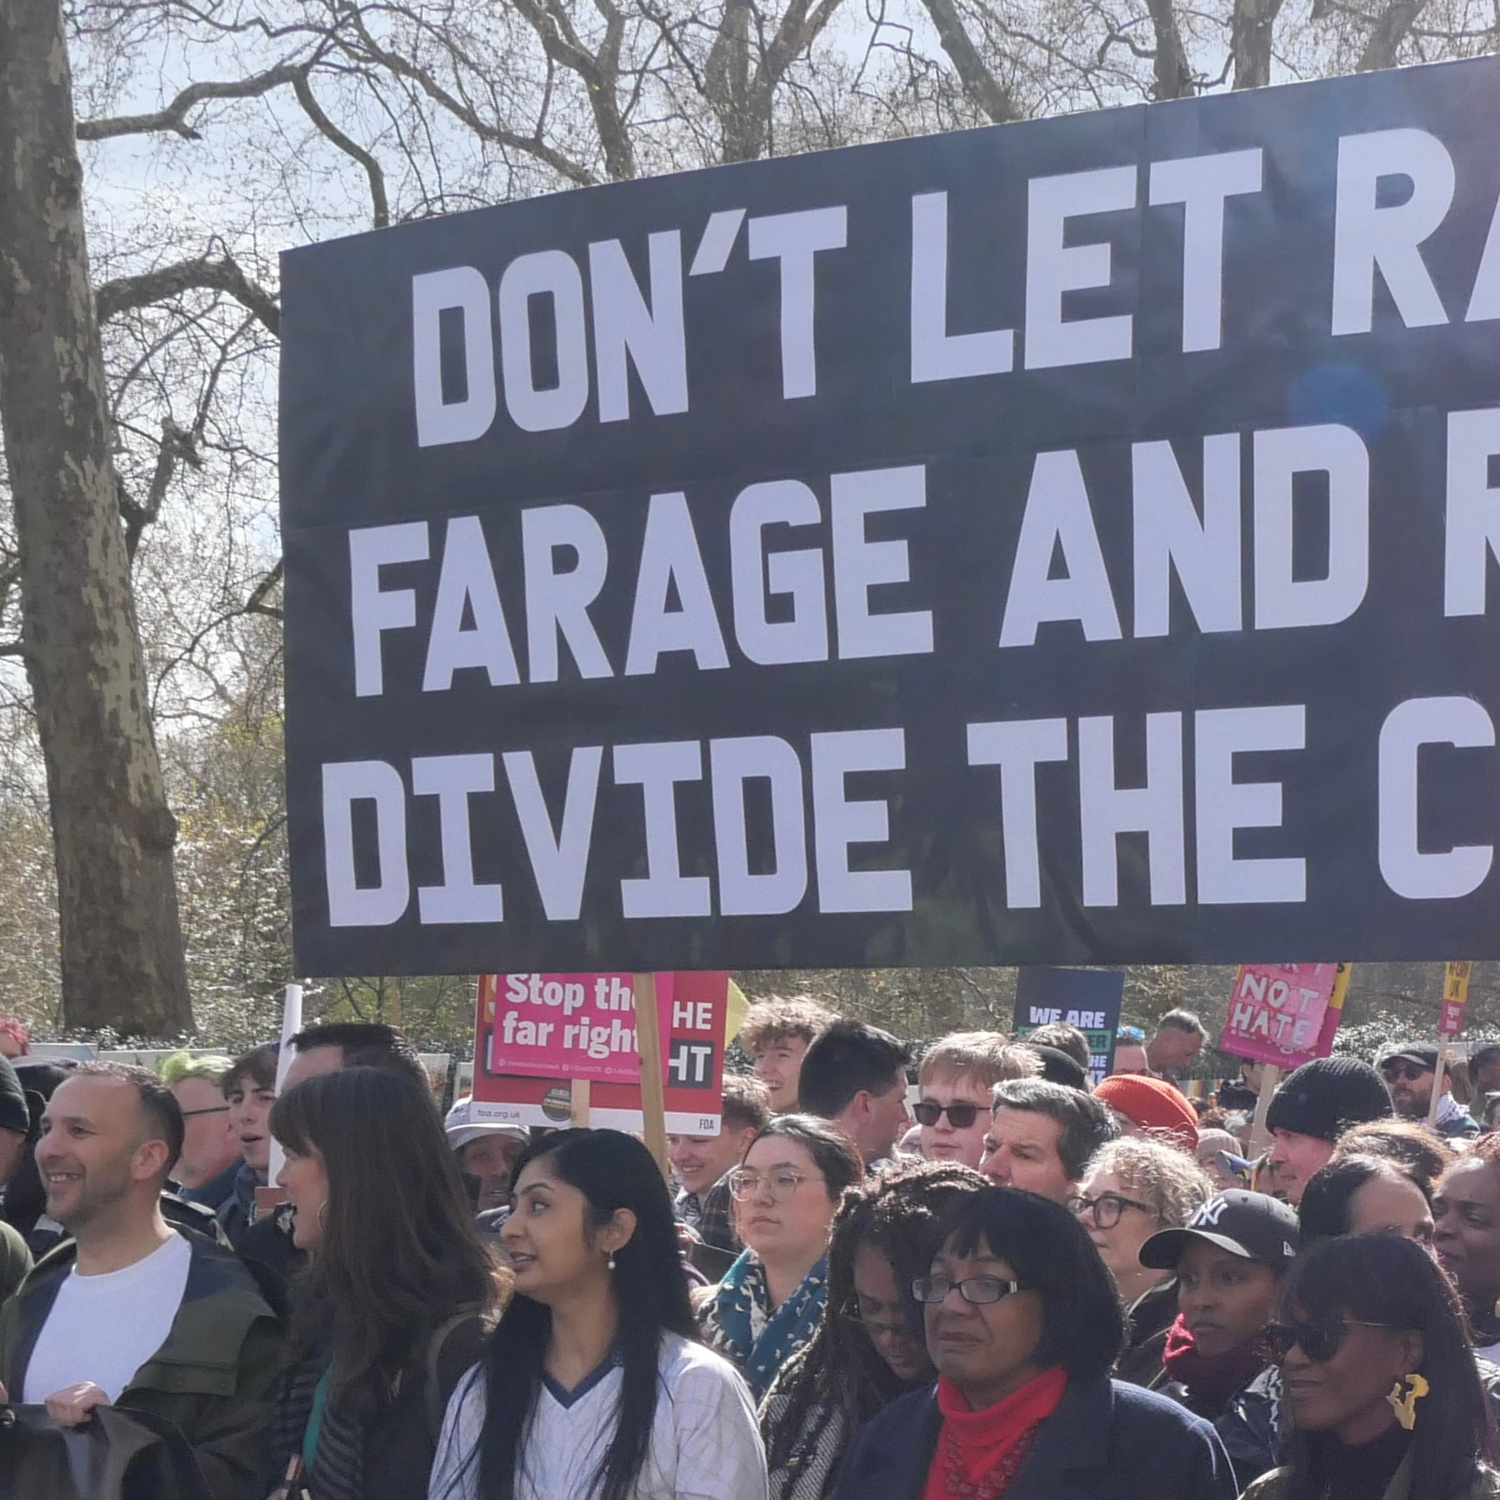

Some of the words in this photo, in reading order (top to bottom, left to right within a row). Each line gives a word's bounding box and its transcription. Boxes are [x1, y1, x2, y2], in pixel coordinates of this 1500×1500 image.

[412, 206, 847, 448] DON'T
[911, 147, 1263, 384] LET
[349, 464, 933, 697] FARAGE
[999, 423, 1370, 649] AND
[322, 727, 912, 928] DIVIDE
[967, 705, 1306, 910] THE
[505, 974, 585, 1015] Stop
[594, 977, 637, 1012] th
[1240, 973, 1319, 1012] NOT
[502, 1011, 554, 1047] far
[672, 1001, 713, 1030] HE
[1029, 1006, 1062, 1025] WE
[1065, 1010, 1105, 1028] ARE
[1230, 1002, 1314, 1046] HATE
[699, 1118, 714, 1130] FOA
